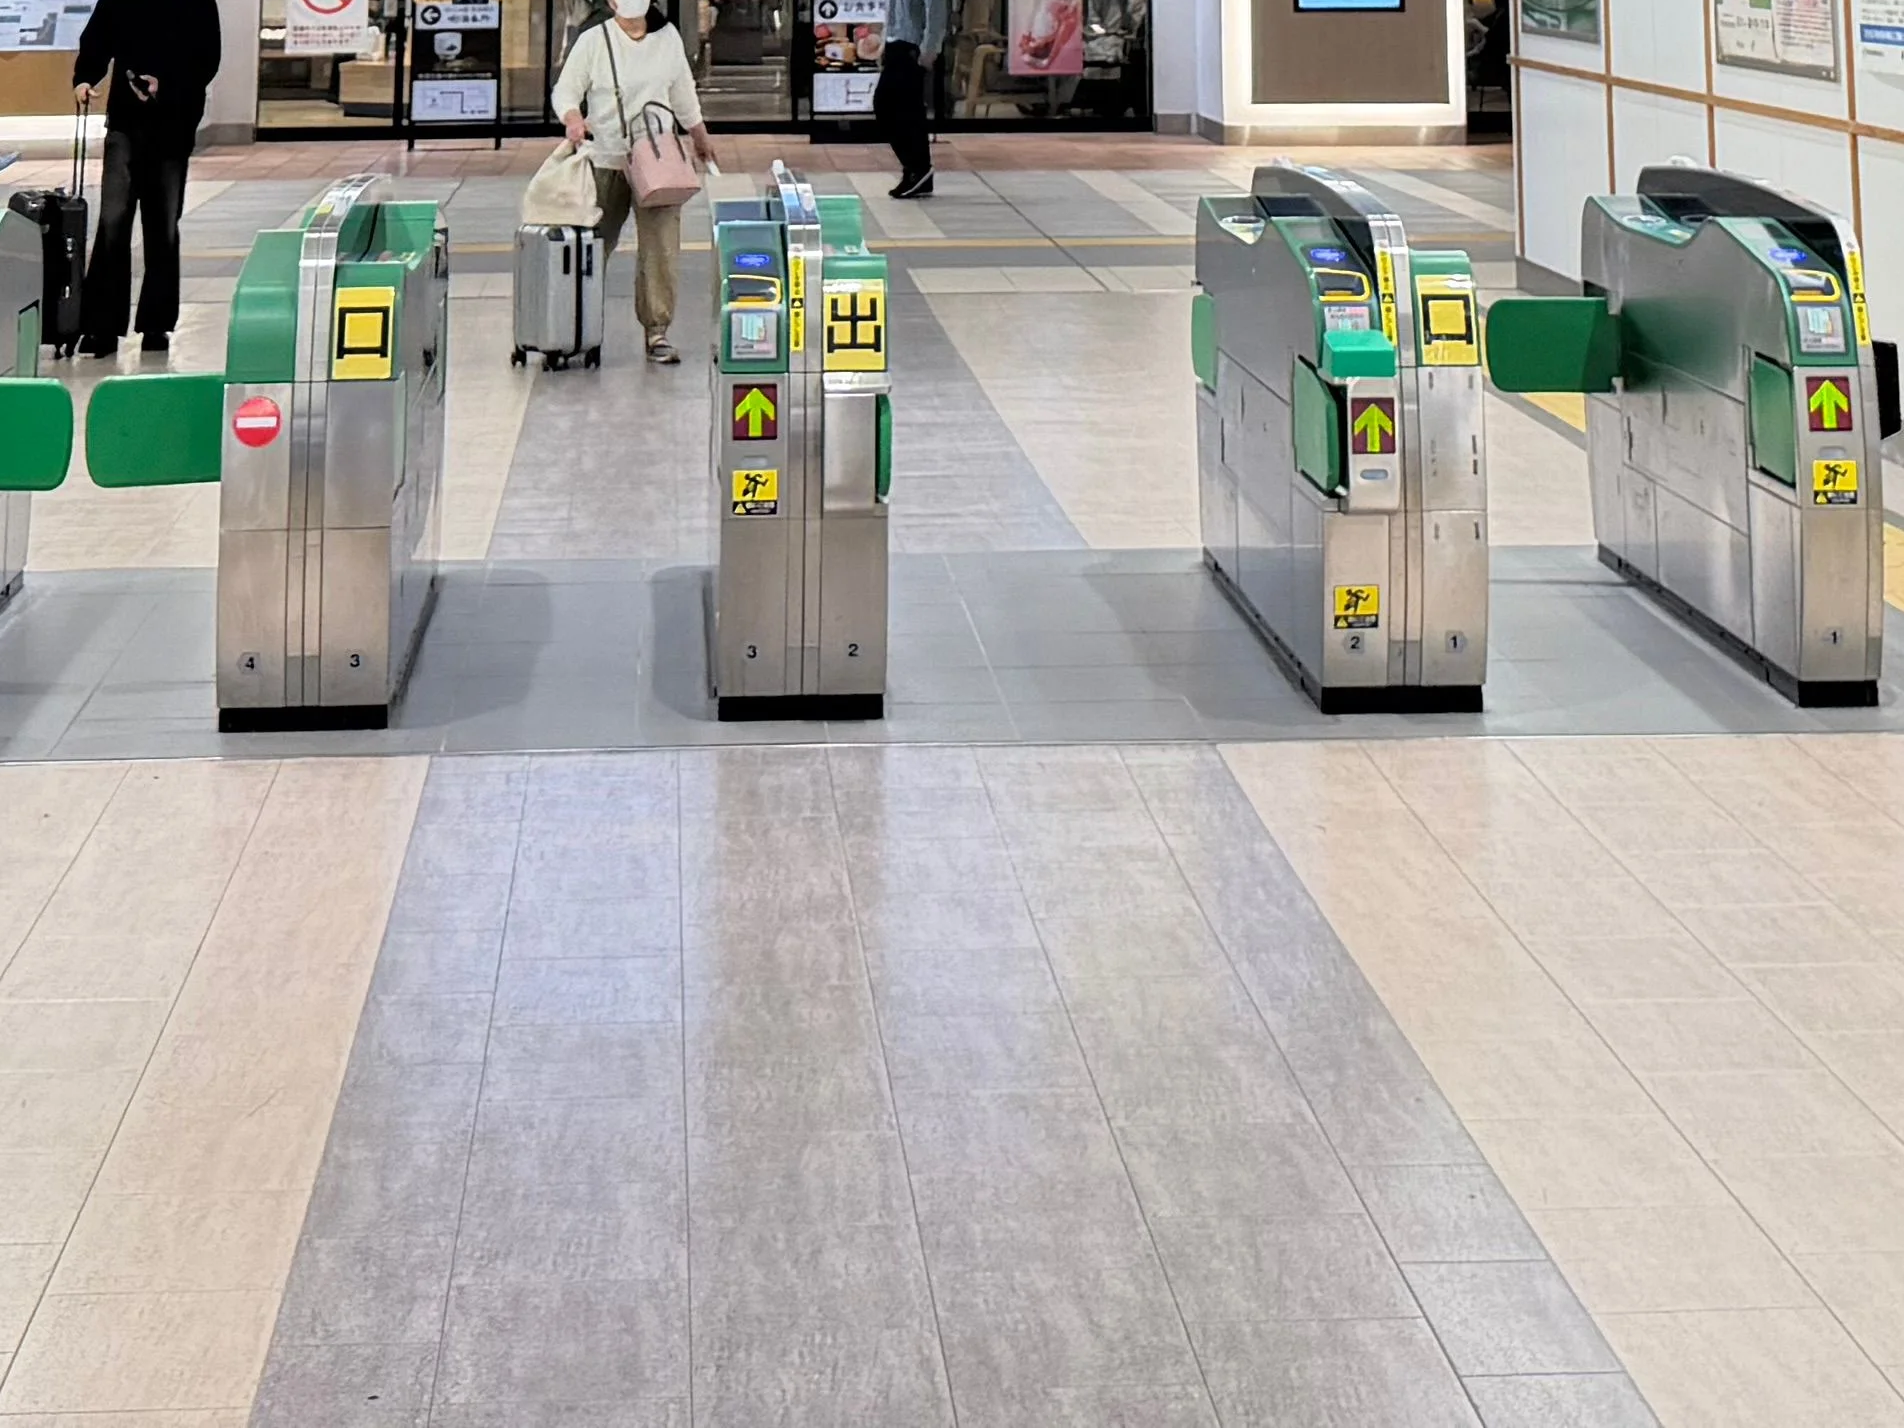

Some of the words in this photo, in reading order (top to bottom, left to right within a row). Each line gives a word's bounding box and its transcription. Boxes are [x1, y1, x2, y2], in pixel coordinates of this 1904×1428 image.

[827, 293, 881, 354] 出
[1420, 293, 1474, 345] 口
[336, 306, 390, 359] 口
[1350, 635, 1360, 650] 2
[1449, 635, 1458, 649] 1
[1829, 631, 1838, 644] 1
[746, 645, 757, 659] 3
[848, 643, 859, 657] 2
[244, 657, 255, 671] 4
[349, 653, 360, 668] 3
